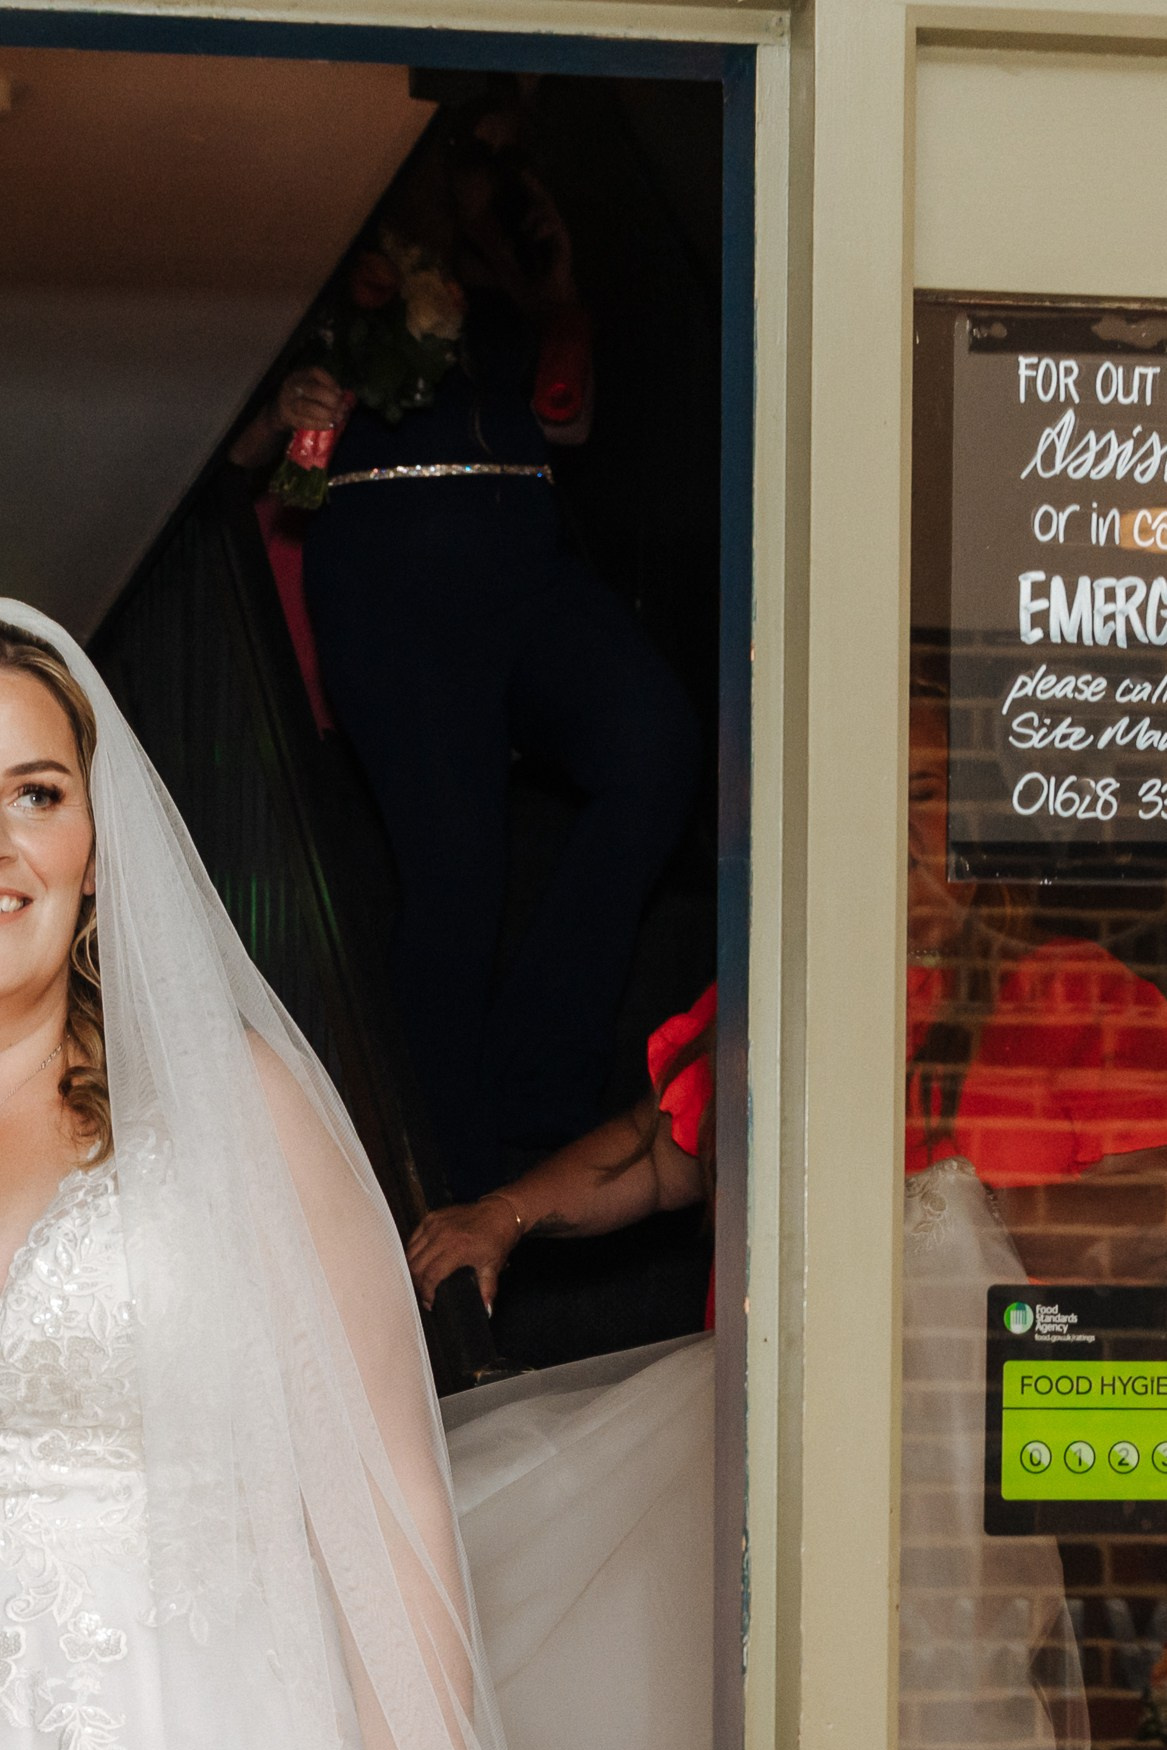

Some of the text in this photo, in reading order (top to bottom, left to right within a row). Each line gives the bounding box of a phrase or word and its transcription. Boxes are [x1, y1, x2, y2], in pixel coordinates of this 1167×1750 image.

[1018, 355, 1161, 406] FOR OUT
[1020, 408, 1167, 484] Assis
[1033, 504, 1080, 544] or
[1091, 502, 1121, 546] in
[1018, 570, 1167, 649] EMERG
[1001, 663, 1108, 715] please
[1009, 711, 1094, 750] Site
[1035, 1303, 1059, 1315] Food
[1035, 1313, 1078, 1324] Standards
[1035, 1322, 1069, 1334] Agency
[1020, 1375, 1167, 1397] FOOD HYGIE
